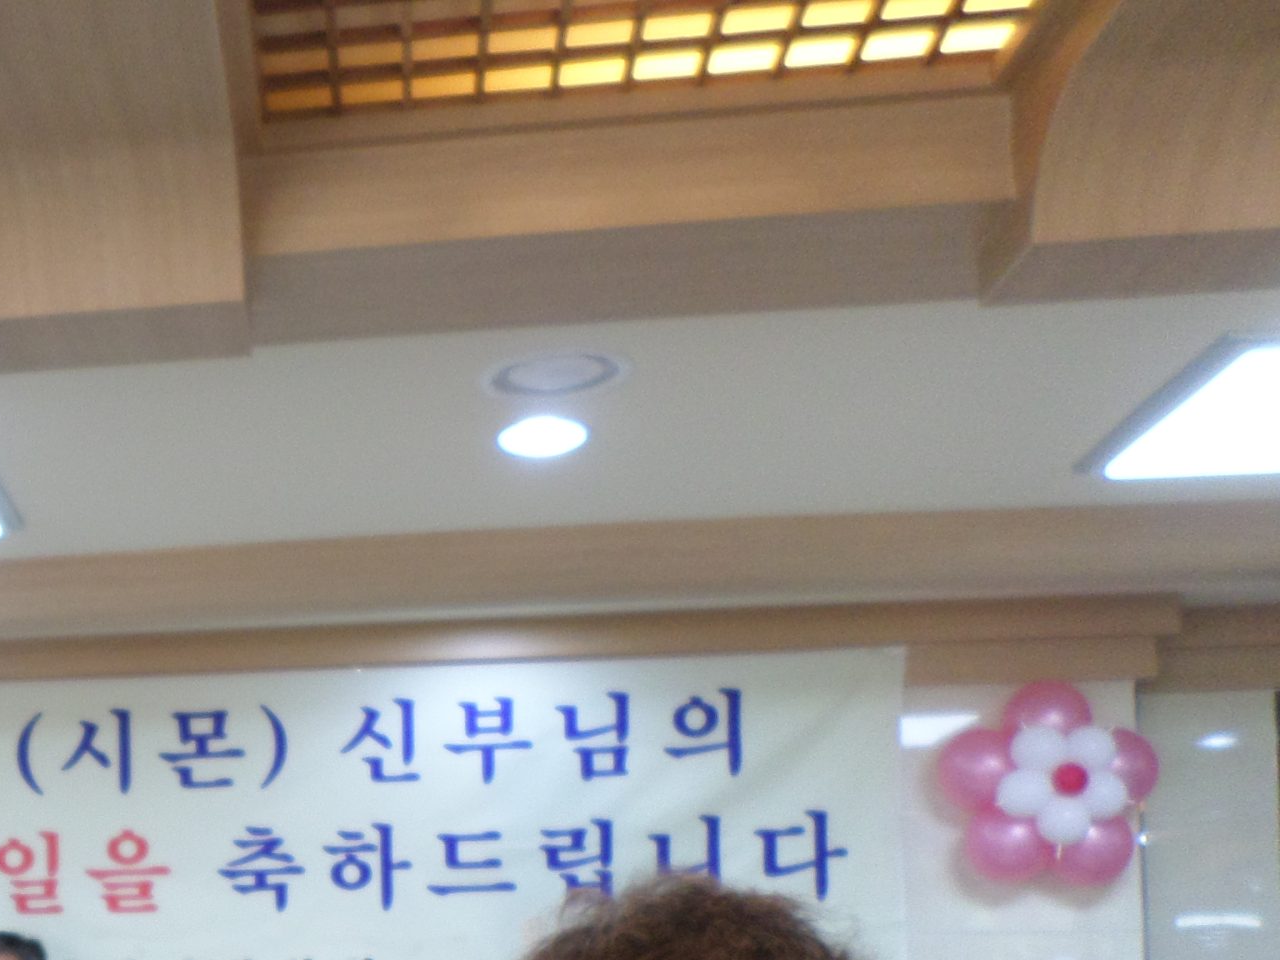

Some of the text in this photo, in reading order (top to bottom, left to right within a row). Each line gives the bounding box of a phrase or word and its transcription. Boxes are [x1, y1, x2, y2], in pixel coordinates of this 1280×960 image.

[16, 703, 289, 797] (시몬)
[340, 687, 743, 785] 신부님의
[217, 809, 850, 913] 축하드립니다
